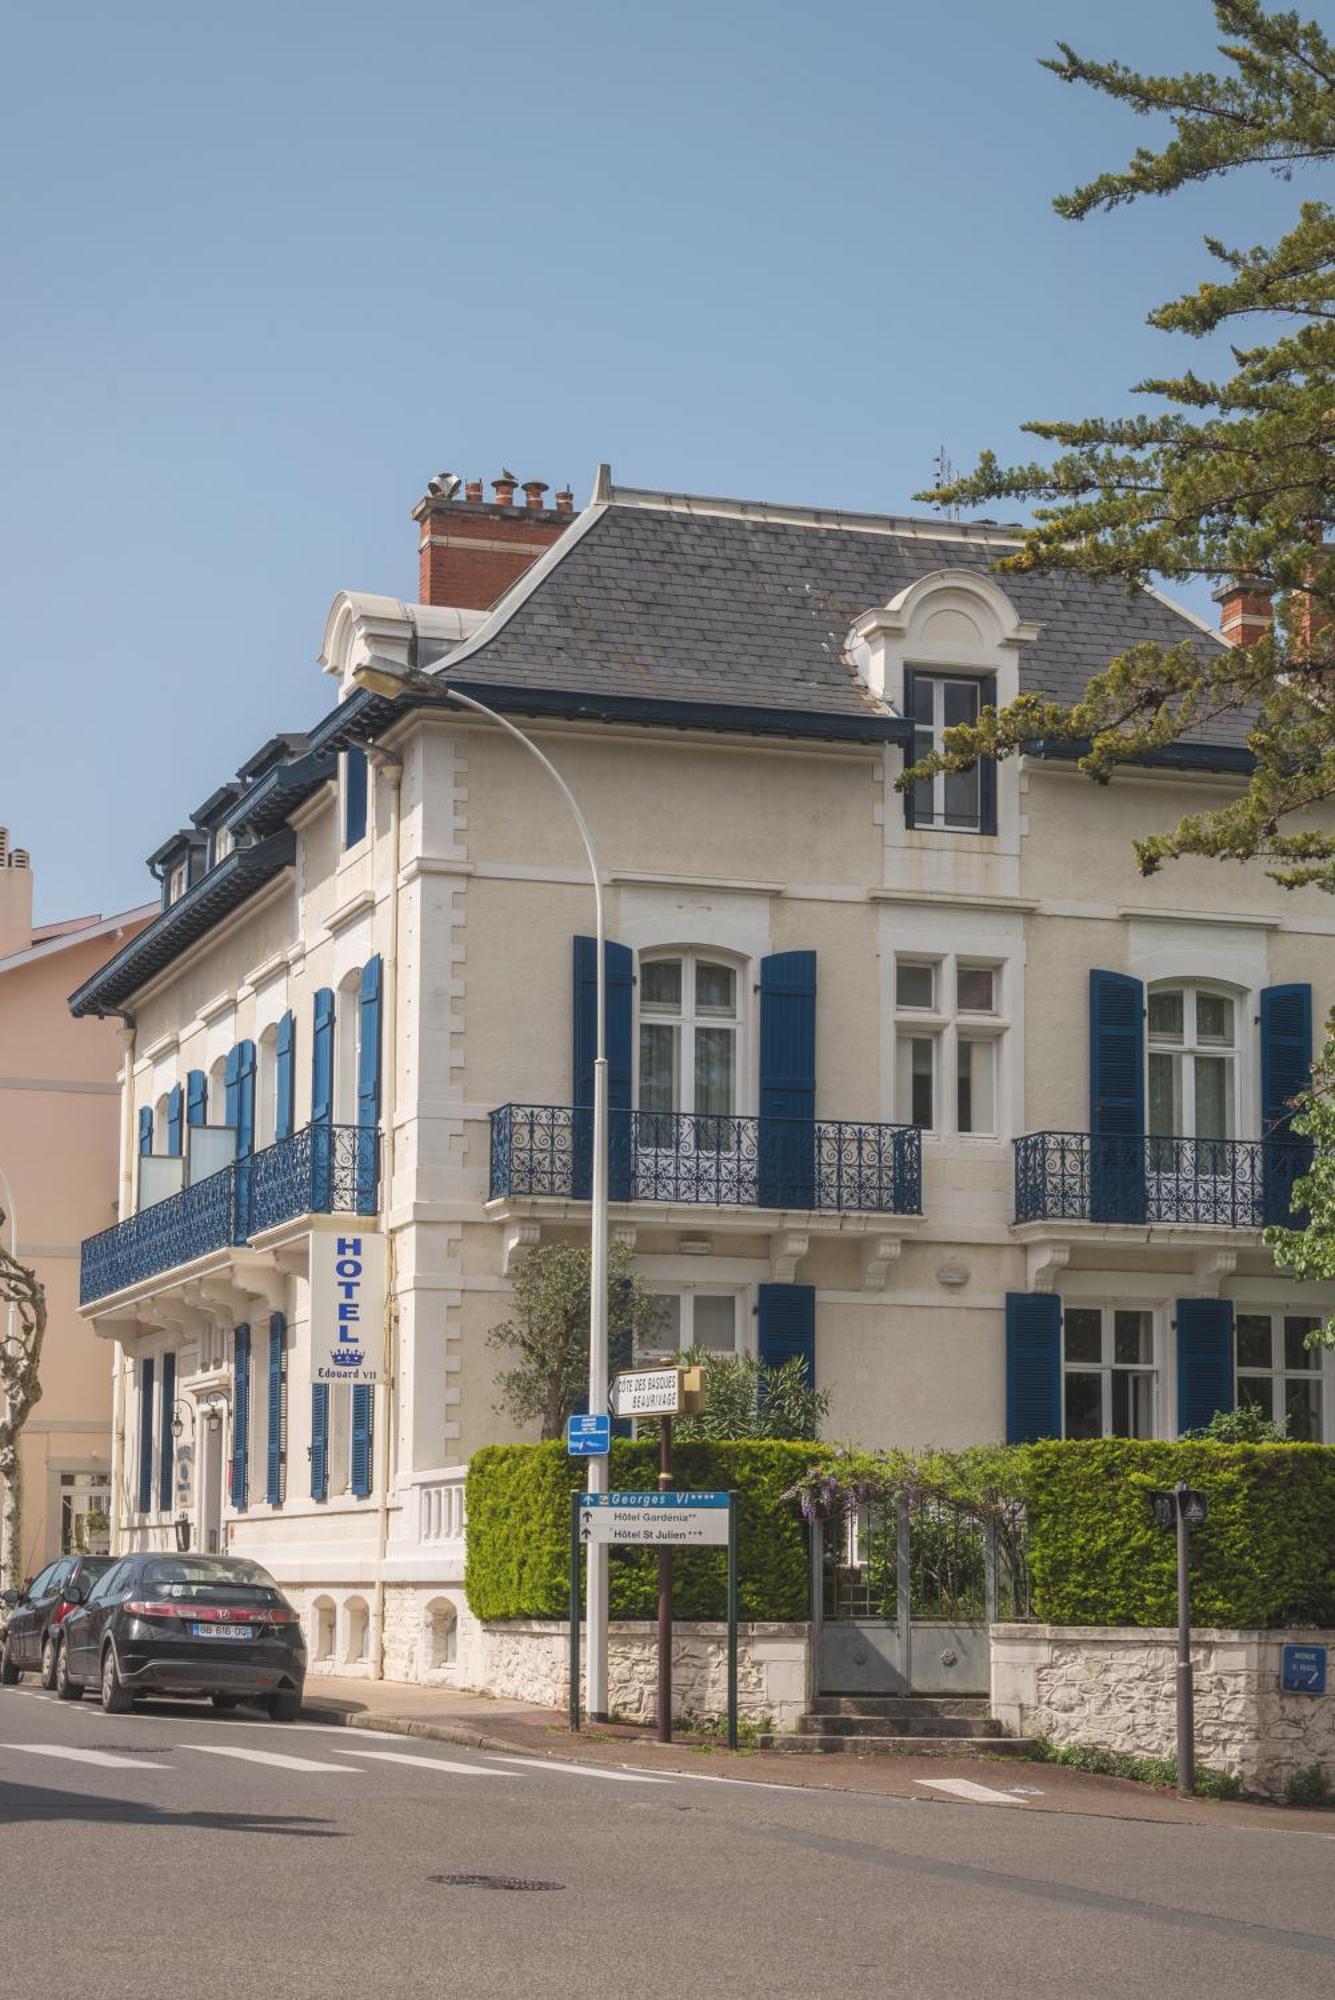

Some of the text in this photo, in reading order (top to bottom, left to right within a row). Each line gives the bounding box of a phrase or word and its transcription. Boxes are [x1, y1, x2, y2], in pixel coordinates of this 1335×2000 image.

[336, 1238, 362, 1343] HOTEL
[318, 1368, 377, 1380] Edouard VII
[635, 1377, 647, 1392] DES
[647, 1375, 676, 1391] BASQUES
[632, 1393, 676, 1409] BEAURIVAGE
[611, 1494, 666, 1506] Georges
[614, 1512, 640, 1522] Hôtel
[614, 1529, 686, 1539] Hôtel St Julien
